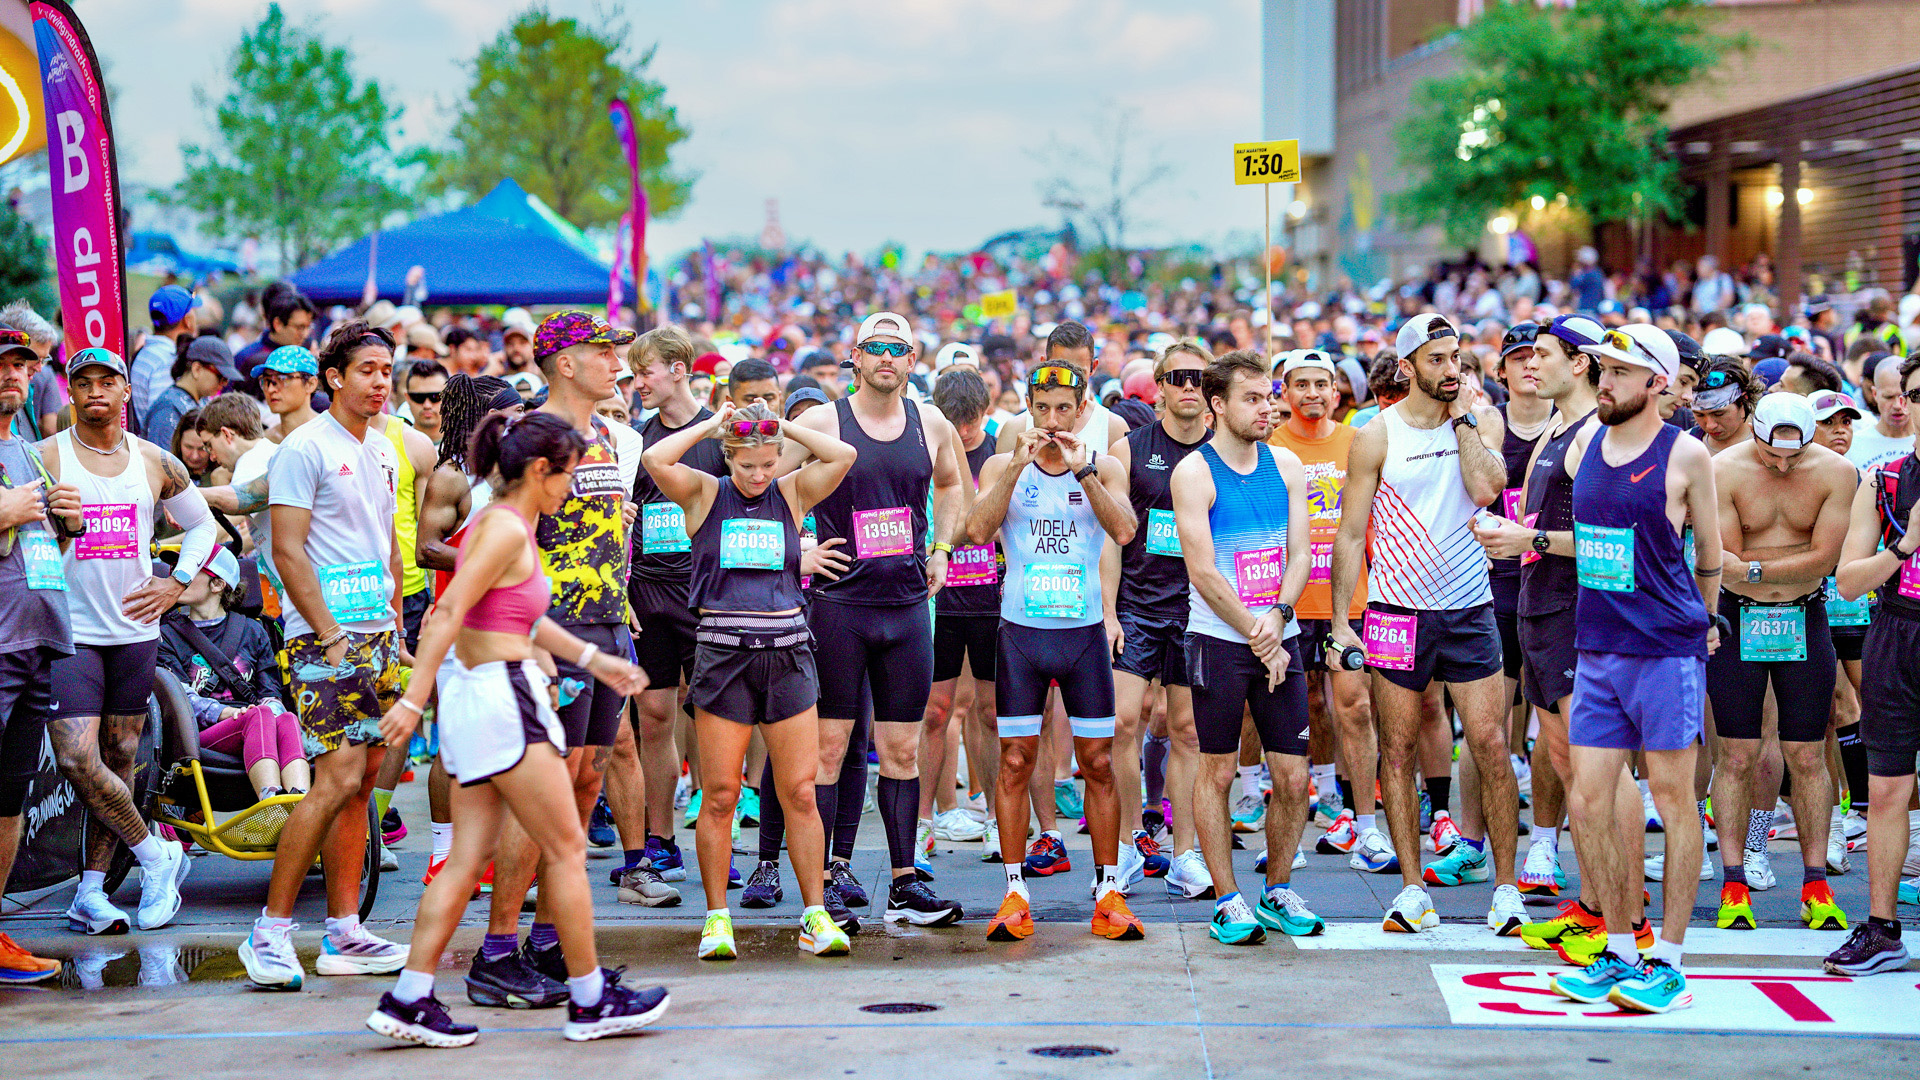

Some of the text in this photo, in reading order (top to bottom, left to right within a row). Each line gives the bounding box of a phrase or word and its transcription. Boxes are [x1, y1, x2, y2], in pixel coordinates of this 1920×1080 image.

[37, 6, 98, 115] .irvingmarathon.co
[56, 109, 90, 194] B
[1243, 153, 1283, 177] 1:30
[1406, 452, 1435, 462] COMPLETELY
[1862, 454, 1883, 469] BANK
[579, 481, 598, 491] FUEL
[85, 516, 131, 534] 13092
[862, 520, 906, 539] 13954
[1029, 519, 1078, 538] VIDELA
[727, 532, 778, 550] 26035
[1034, 537, 1070, 555] ARG
[1579, 538, 1626, 561] 26532
[952, 548, 989, 565] 13138
[1067, 568, 1083, 576] ELITE
[1243, 560, 1280, 581] 13296
[329, 574, 379, 596] 26200
[1031, 575, 1080, 592] 26002
[1367, 624, 1408, 645] 13264
[1750, 619, 1797, 636] 26371
[1009, 873, 1020, 883] R
[1106, 875, 1116, 884] R
[1661, 978, 1680, 995] HOKA
